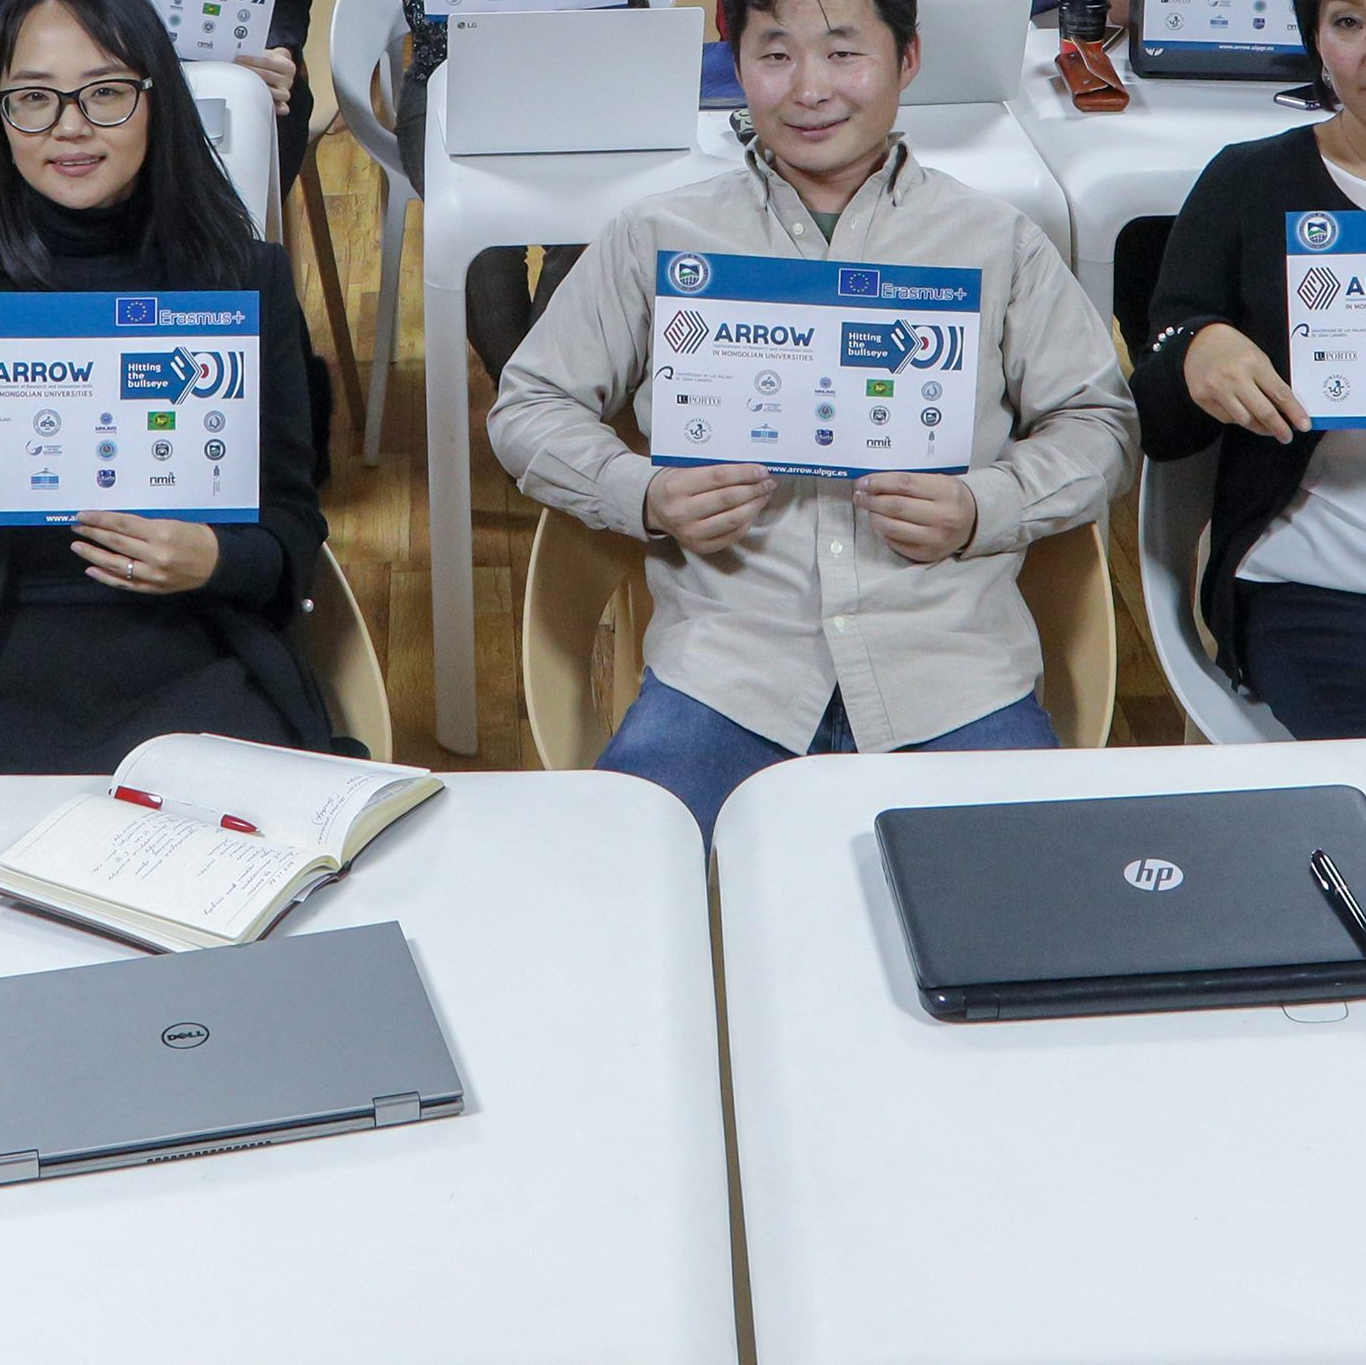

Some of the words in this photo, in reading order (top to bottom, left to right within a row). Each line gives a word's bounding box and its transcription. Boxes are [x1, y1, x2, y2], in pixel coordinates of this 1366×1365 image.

[882, 283, 967, 300] Erasmus+
[159, 310, 245, 325] Erasmus+
[714, 323, 814, 346] ARROW
[849, 332, 882, 343] Hitting
[849, 340, 865, 348] the
[848, 348, 888, 357] bullseye
[128, 363, 161, 373] Hitting
[128, 379, 168, 387] bullseye
[867, 436, 892, 447] nmit
[150, 473, 175, 484] nmit
[1136, 860, 1173, 891] hp
[167, 1031, 204, 1040] DELL
